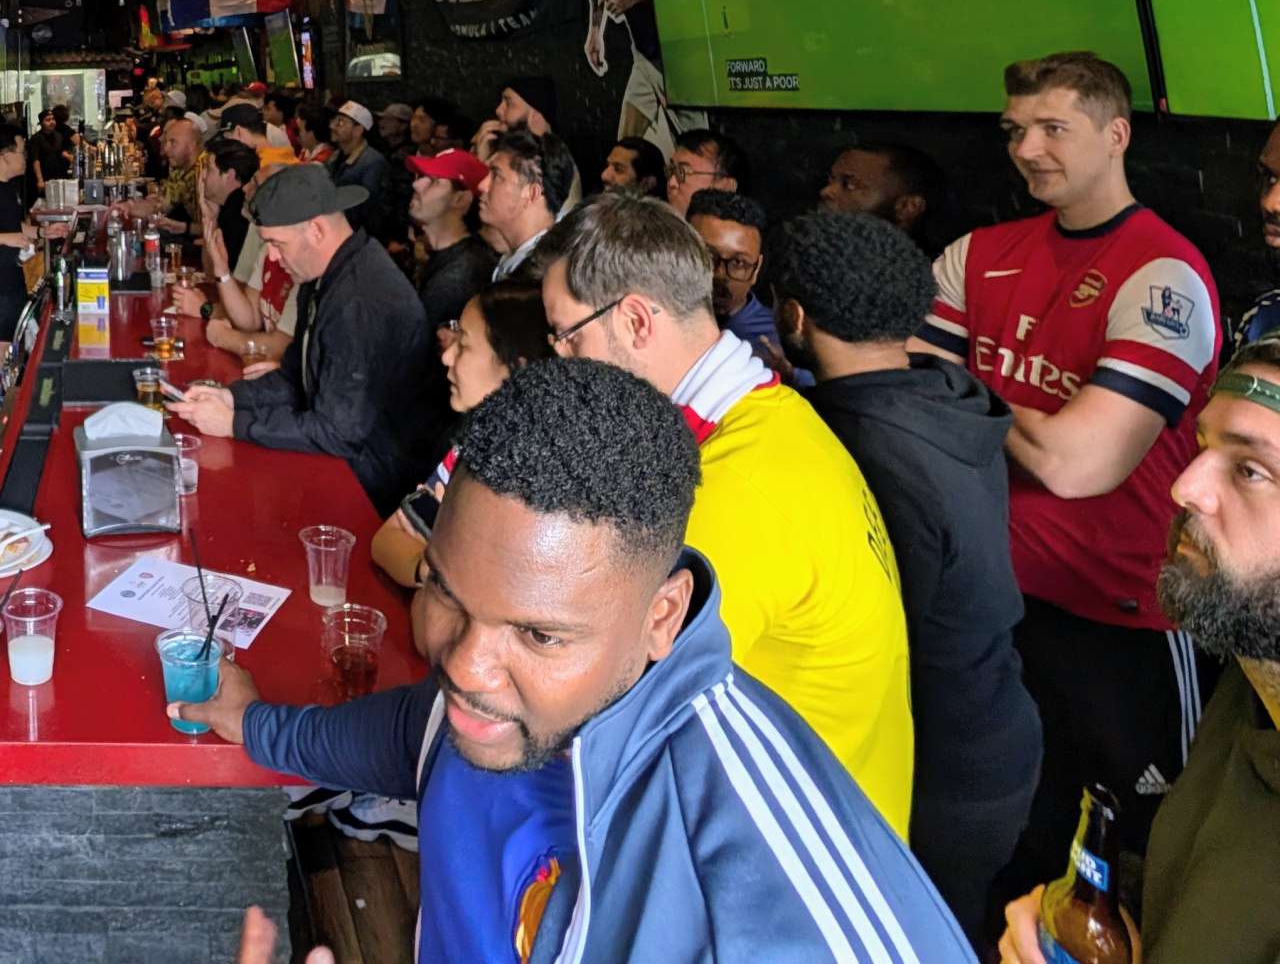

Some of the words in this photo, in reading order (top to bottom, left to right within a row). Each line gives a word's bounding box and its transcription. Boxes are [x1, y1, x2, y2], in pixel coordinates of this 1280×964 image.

[743, 76, 763, 89] JUST
[765, 76, 773, 89] A
[773, 76, 799, 89] POOR
